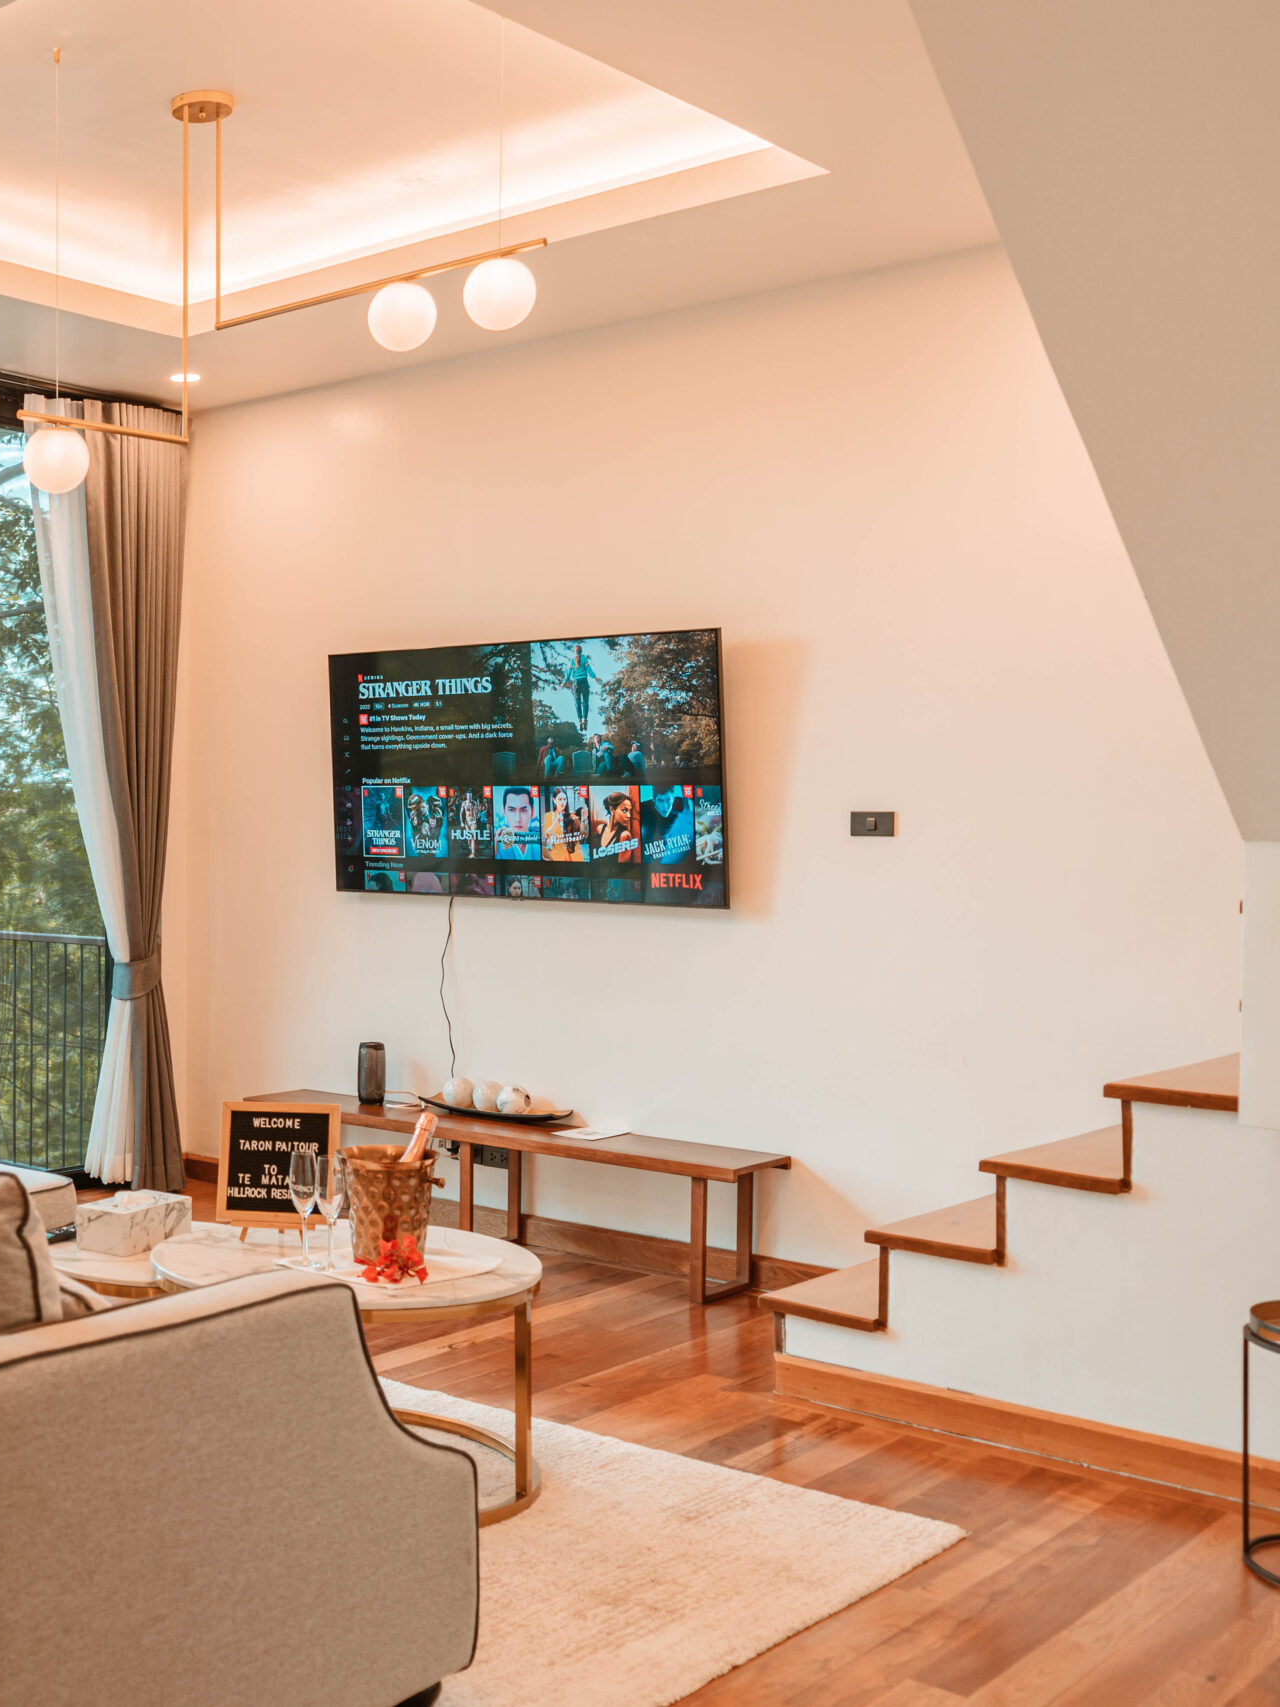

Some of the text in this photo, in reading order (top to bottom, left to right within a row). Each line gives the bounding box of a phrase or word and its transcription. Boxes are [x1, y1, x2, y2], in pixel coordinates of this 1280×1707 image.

[358, 676, 492, 699] STRANGER THINGS
[408, 714, 426, 722] Today
[390, 725, 414, 733] Hawkins,
[360, 735, 380, 743] Strange
[381, 734, 405, 742] sightings.
[385, 743, 412, 751] everything
[362, 777, 384, 786] Popular
[367, 829, 401, 838] STRANGER
[451, 829, 490, 840] HUSTLE
[372, 837, 396, 846] THINGS
[411, 835, 442, 850] VENOM
[593, 838, 639, 859] LOSERS
[644, 839, 666, 856] JACK
[365, 861, 390, 869] Trending
[651, 872, 703, 890] NETFLIX
[253, 1117, 301, 1129] WELCOME
[239, 1139, 273, 1151] TARON
[263, 1164, 278, 1175] TO
[238, 1173, 251, 1185] TE
[227, 1186, 268, 1199] HILLROCK
